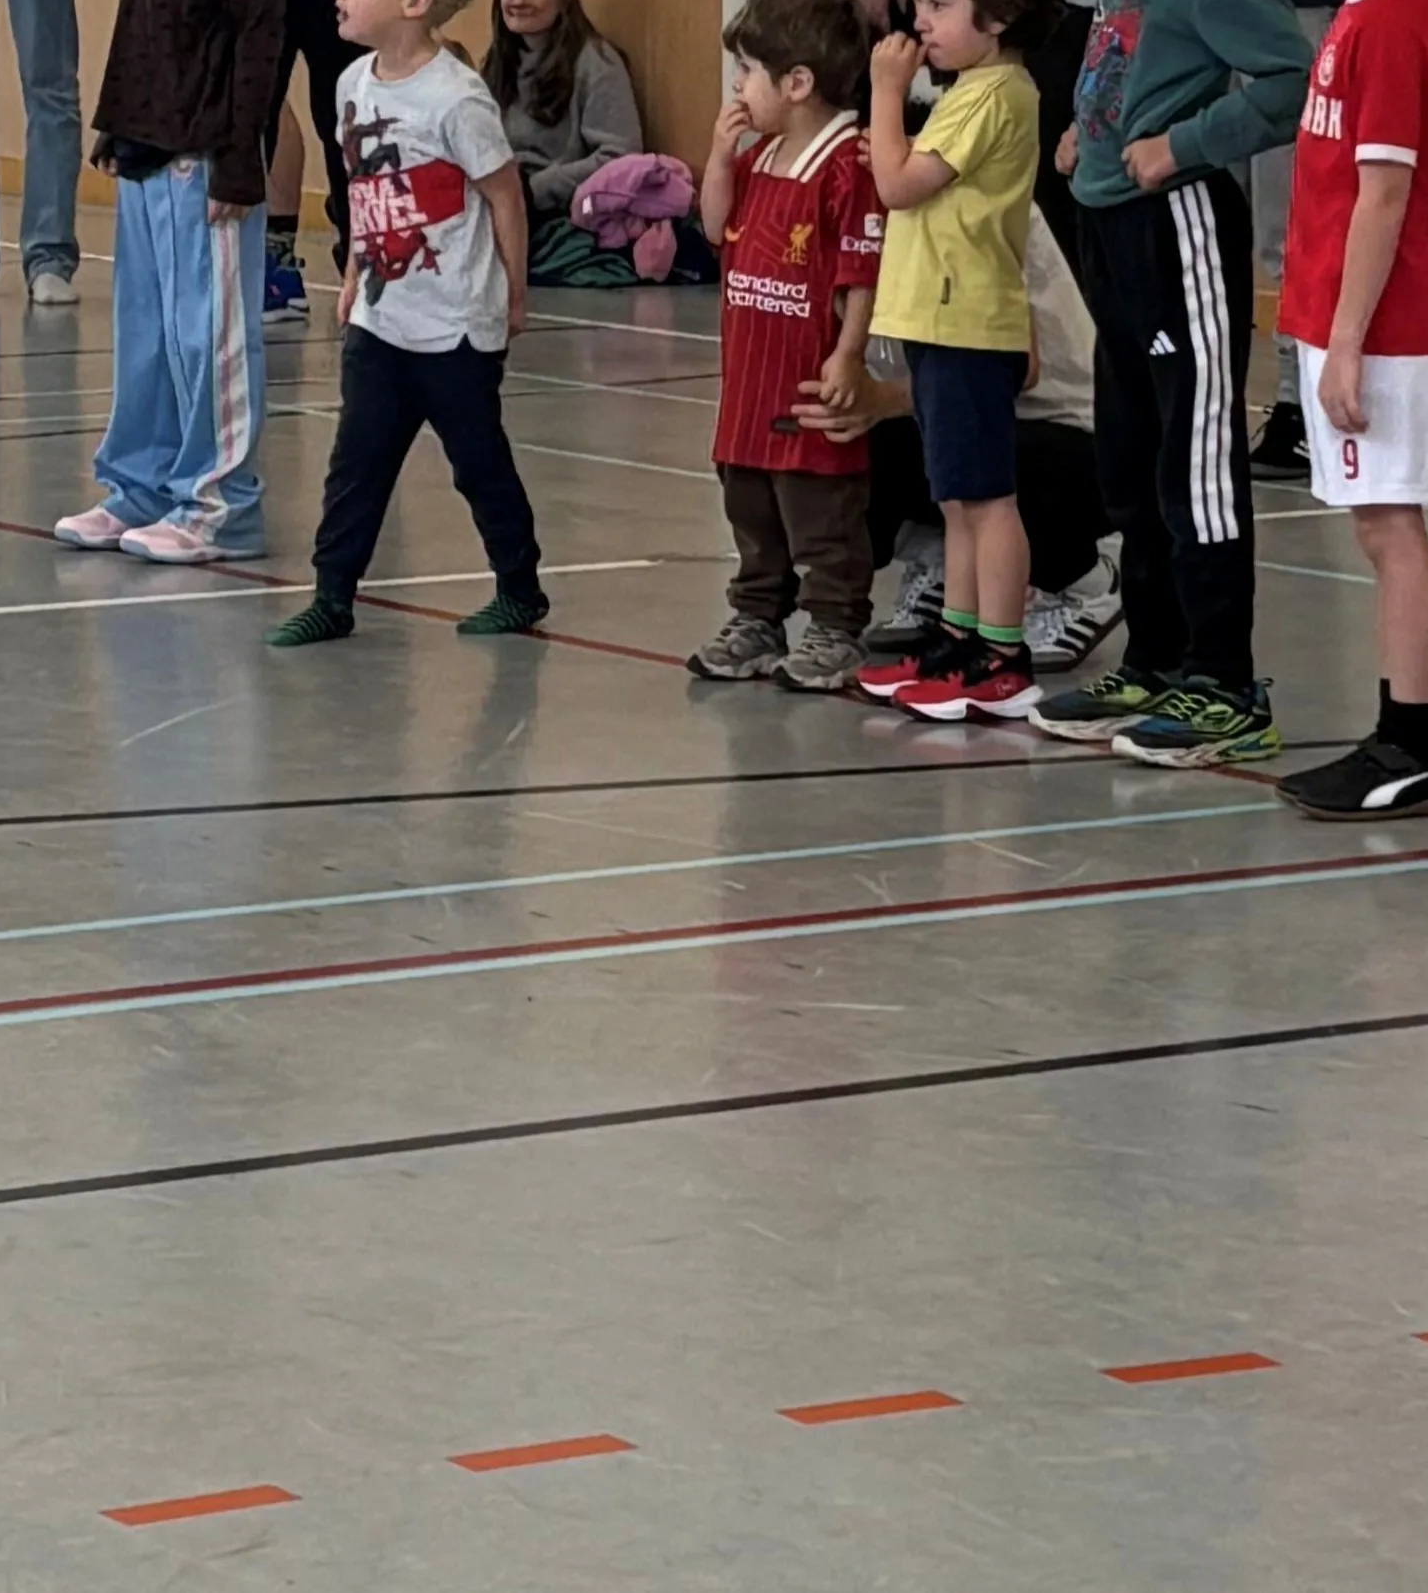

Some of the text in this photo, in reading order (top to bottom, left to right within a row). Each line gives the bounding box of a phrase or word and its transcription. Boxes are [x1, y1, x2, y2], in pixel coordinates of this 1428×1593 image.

[727, 268, 808, 300] tandard
[726, 288, 811, 318] hartered
[1342, 438, 1359, 480] 9
